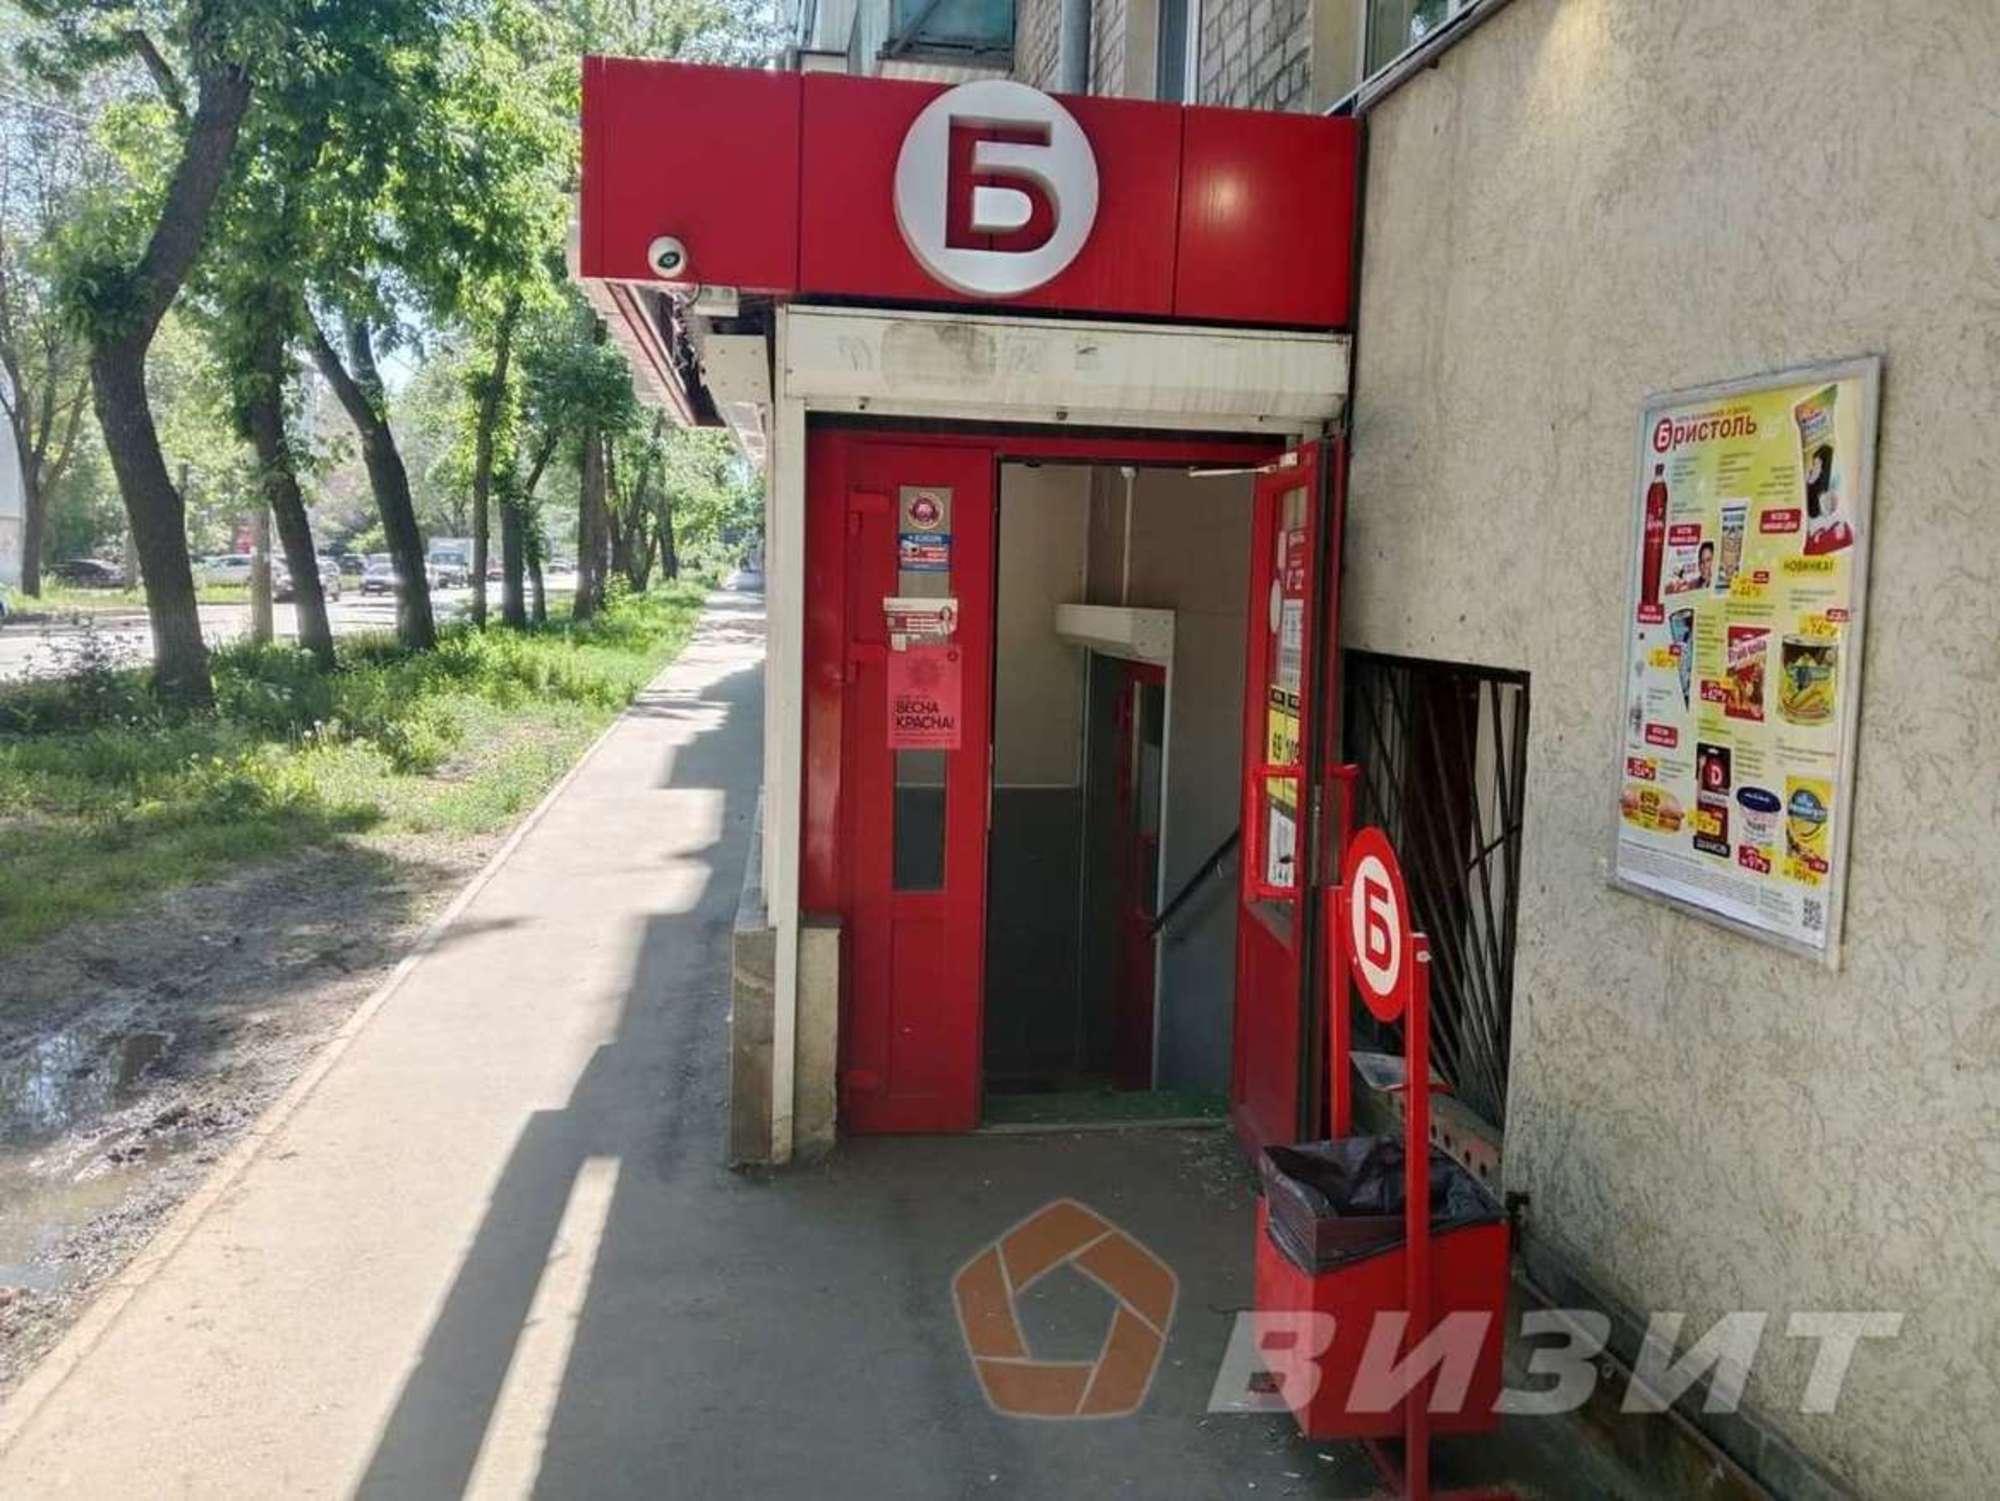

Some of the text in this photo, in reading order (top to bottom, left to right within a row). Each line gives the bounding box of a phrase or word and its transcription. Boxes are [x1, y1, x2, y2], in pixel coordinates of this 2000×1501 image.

[945, 113, 1059, 254] Б
[896, 701, 939, 713] ВЕСНА
[896, 715, 955, 730] КРАСНА!
[1364, 875, 1392, 971] Б
